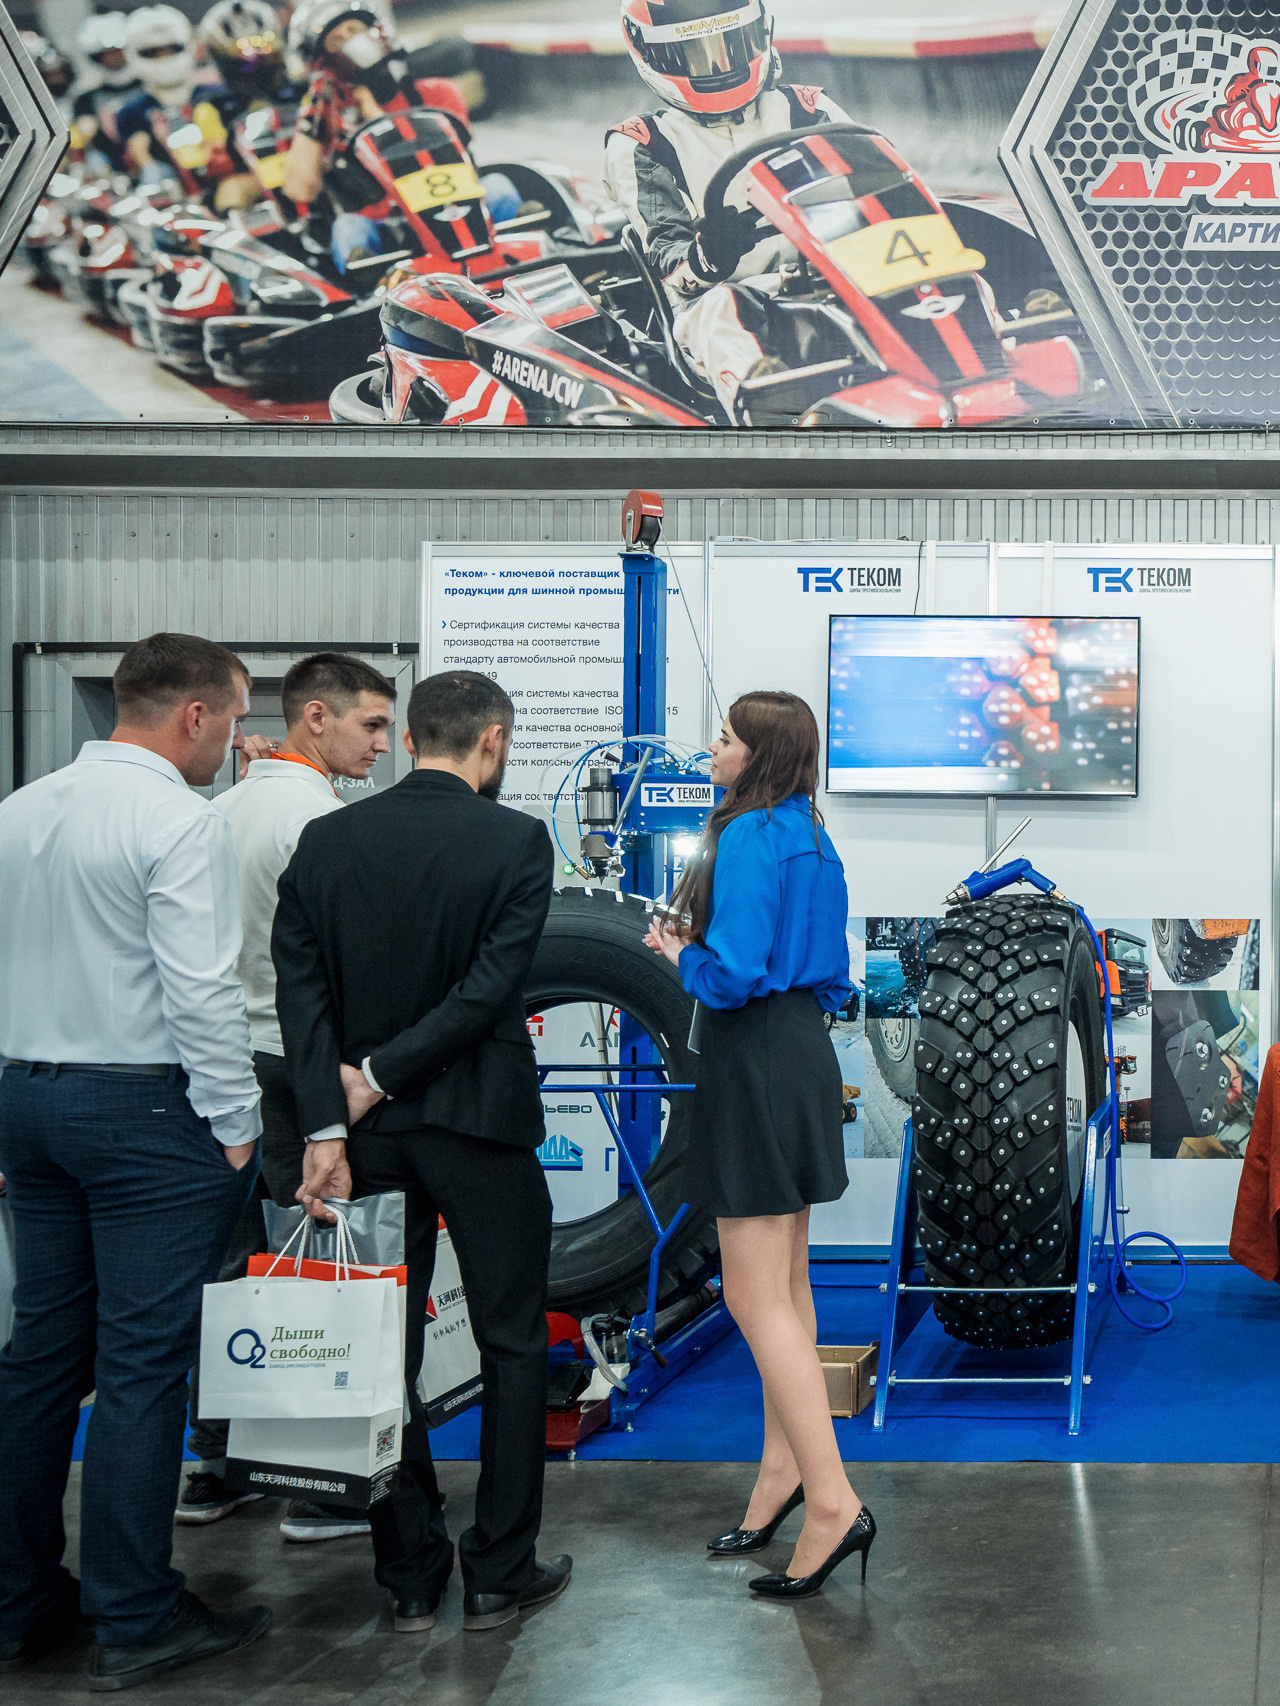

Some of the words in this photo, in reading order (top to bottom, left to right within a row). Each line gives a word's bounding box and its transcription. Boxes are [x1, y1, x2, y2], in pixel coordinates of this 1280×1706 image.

[425, 172, 457, 197] 8
[886, 229, 929, 268] 4
[492, 350, 584, 409] #ARENAJCW
[500, 569, 554, 577] ключевой
[559, 571, 620, 579] поставщик
[847, 567, 901, 586] ТЕКОМ
[1137, 567, 1191, 586] ТЕКОМ
[445, 588, 504, 597] продукции
[508, 588, 527, 596] для
[532, 586, 575, 594] шинной
[450, 620, 524, 631] Сертификация
[444, 639, 514, 649] производства
[444, 656, 494, 665] стандарту
[497, 654, 575, 663] автомобильной
[605, 706, 623, 715] ISO
[677, 787, 711, 799] ТЕКОМ
[271, 1326, 325, 1343] Дыши
[269, 1343, 351, 1361] свободно!
